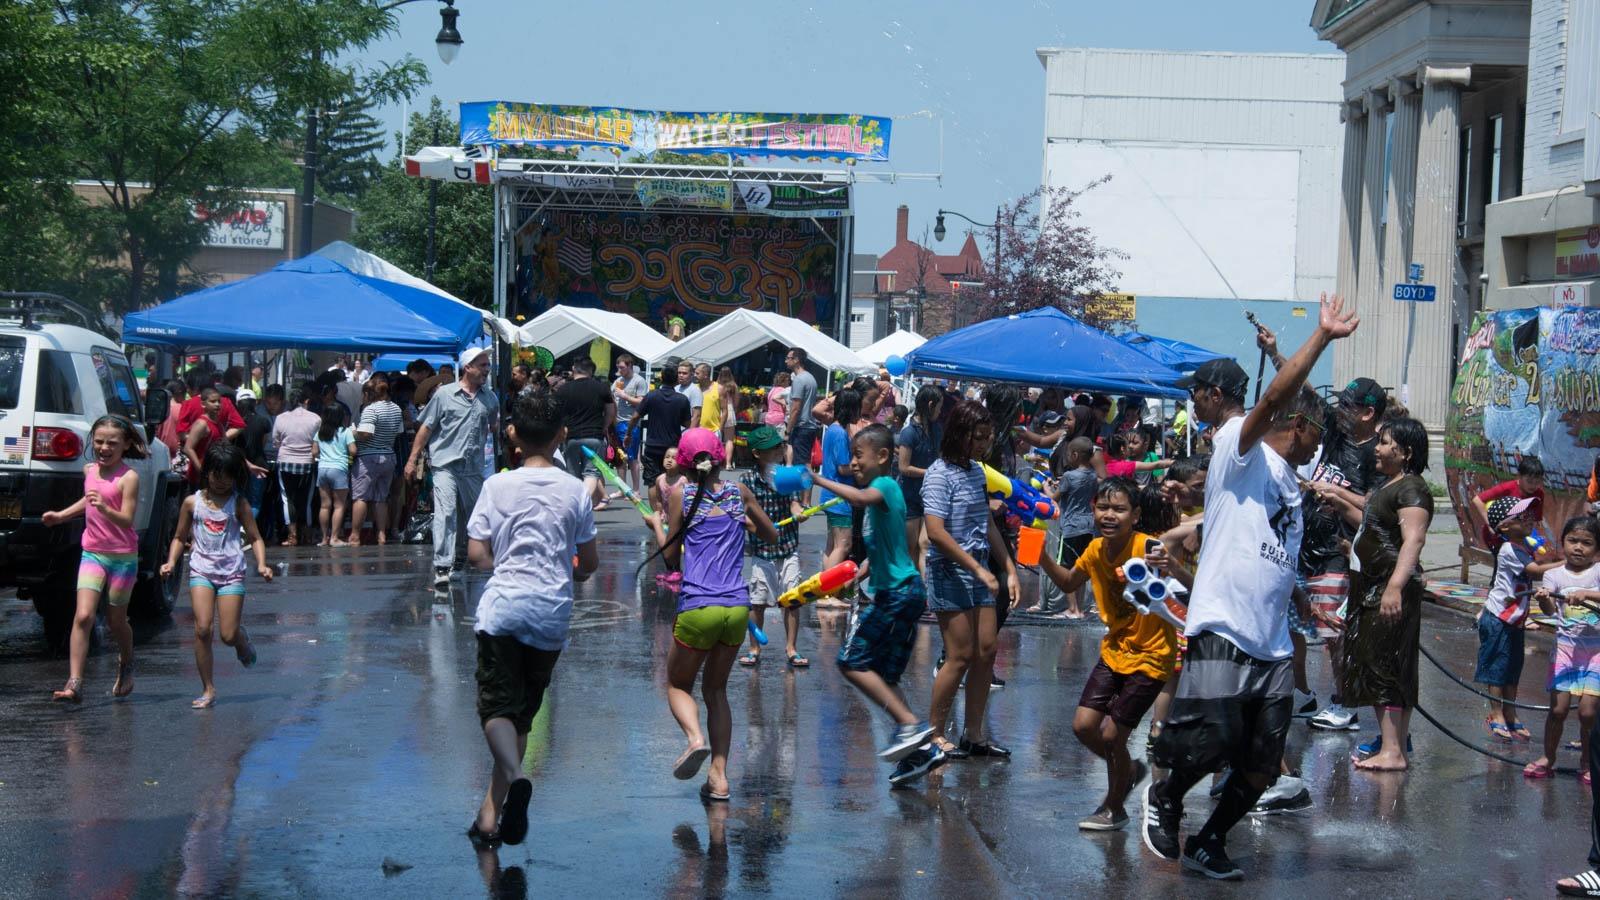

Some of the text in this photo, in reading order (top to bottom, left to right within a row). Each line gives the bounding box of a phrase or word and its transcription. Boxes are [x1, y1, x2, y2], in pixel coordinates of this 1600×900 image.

[496, 112, 871, 154] MYANMAR WATER FESTIVAL
[774, 186, 801, 199] LIME
[232, 235, 271, 246] stores
[1395, 286, 1426, 299] BOYD
[1563, 290, 1576, 300] NO
[136, 327, 178, 336] GARDENLNE
[1261, 542, 1297, 563] BUFAL
